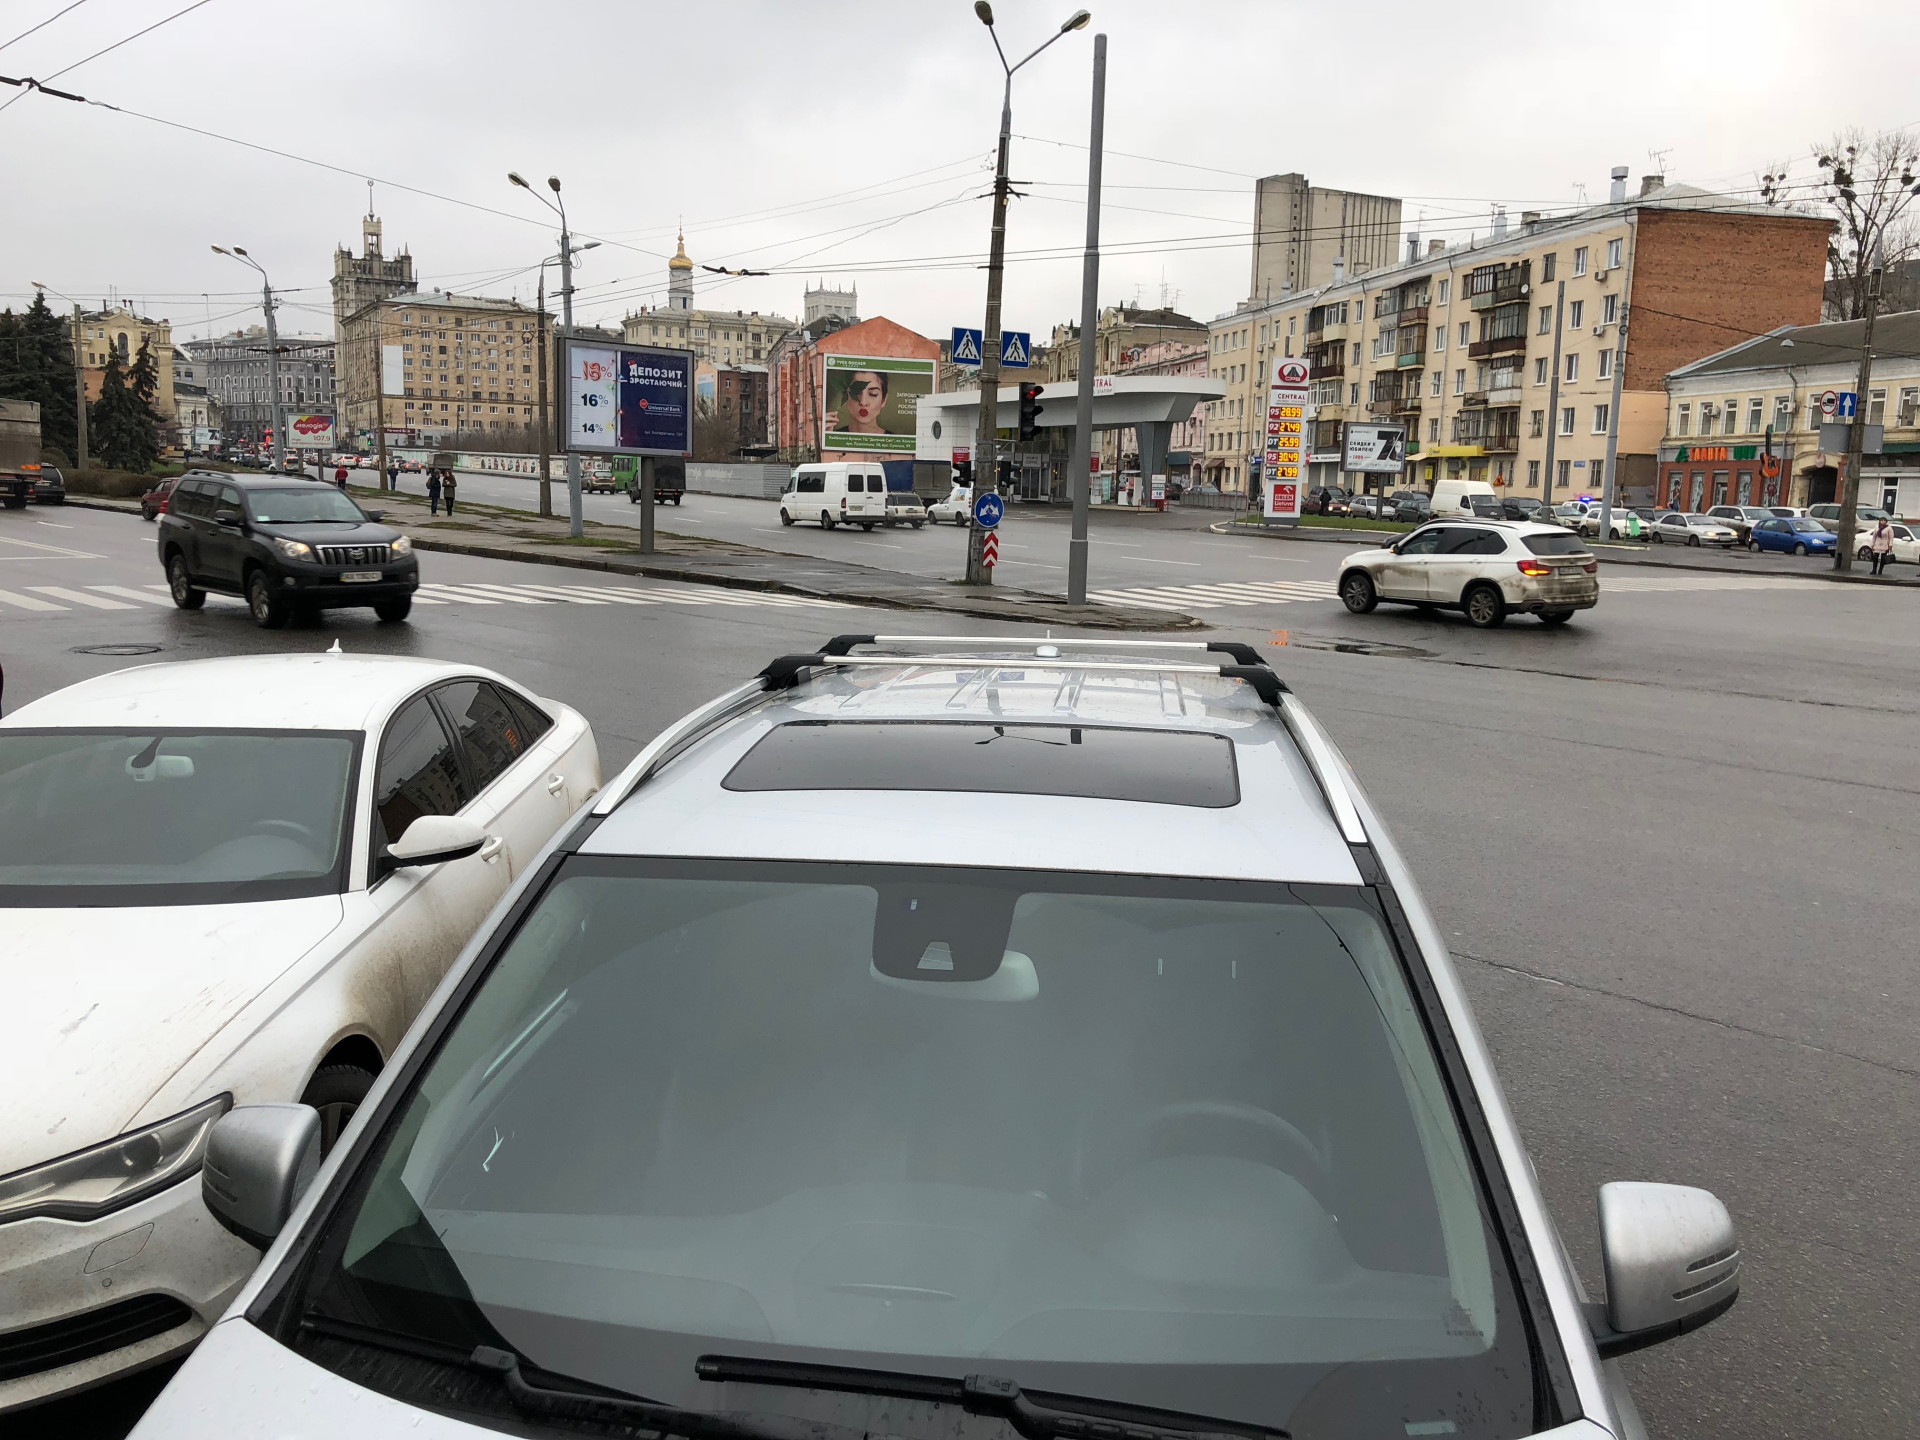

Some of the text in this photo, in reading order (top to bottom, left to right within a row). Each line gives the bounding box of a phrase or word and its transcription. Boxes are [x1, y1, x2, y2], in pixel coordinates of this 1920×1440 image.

[630, 363, 682, 379] ДЕПОЗИТ
[630, 378, 682, 387] ЗРОСТАЮЧИЙ
[581, 393, 608, 407] 16%
[1277, 393, 1306, 401] CENTRAL
[1270, 407, 1302, 417] 95 28.99
[582, 423, 603, 433] 14%
[1269, 422, 1301, 432] 92 27.49
[1267, 437, 1300, 447] DT 25.99
[1267, 453, 1277, 461] 95
[1278, 452, 1299, 462] 30.49
[1266, 468, 1277, 476] DT
[1277, 467, 1298, 477] 27.99
